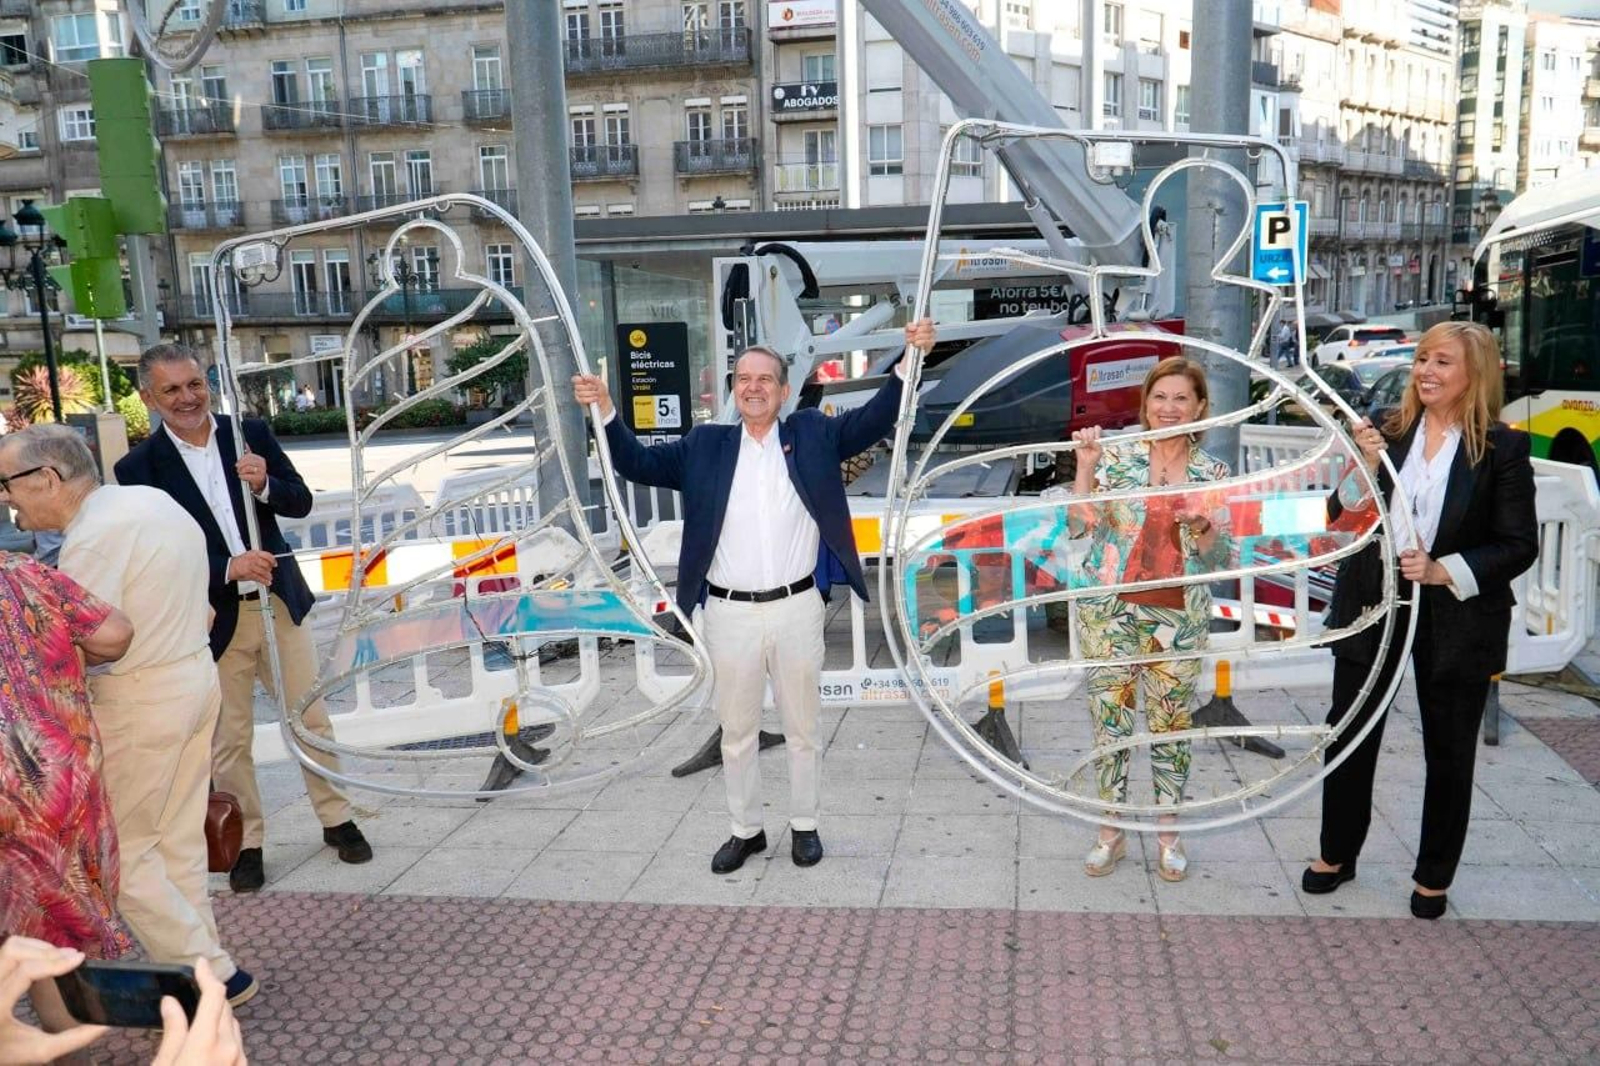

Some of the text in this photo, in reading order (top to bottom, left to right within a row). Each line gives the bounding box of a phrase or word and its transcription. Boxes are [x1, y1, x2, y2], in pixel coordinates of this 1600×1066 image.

[783, 96, 840, 108] ABOGADOS
[1268, 217, 1291, 244] P
[990, 283, 1037, 299] Aforra
[999, 302, 1019, 314] no
[630, 351, 652, 360] Bicis
[630, 360, 675, 369] eléctricas
[658, 398, 669, 416] 5
[931, 677, 950, 687] 619
